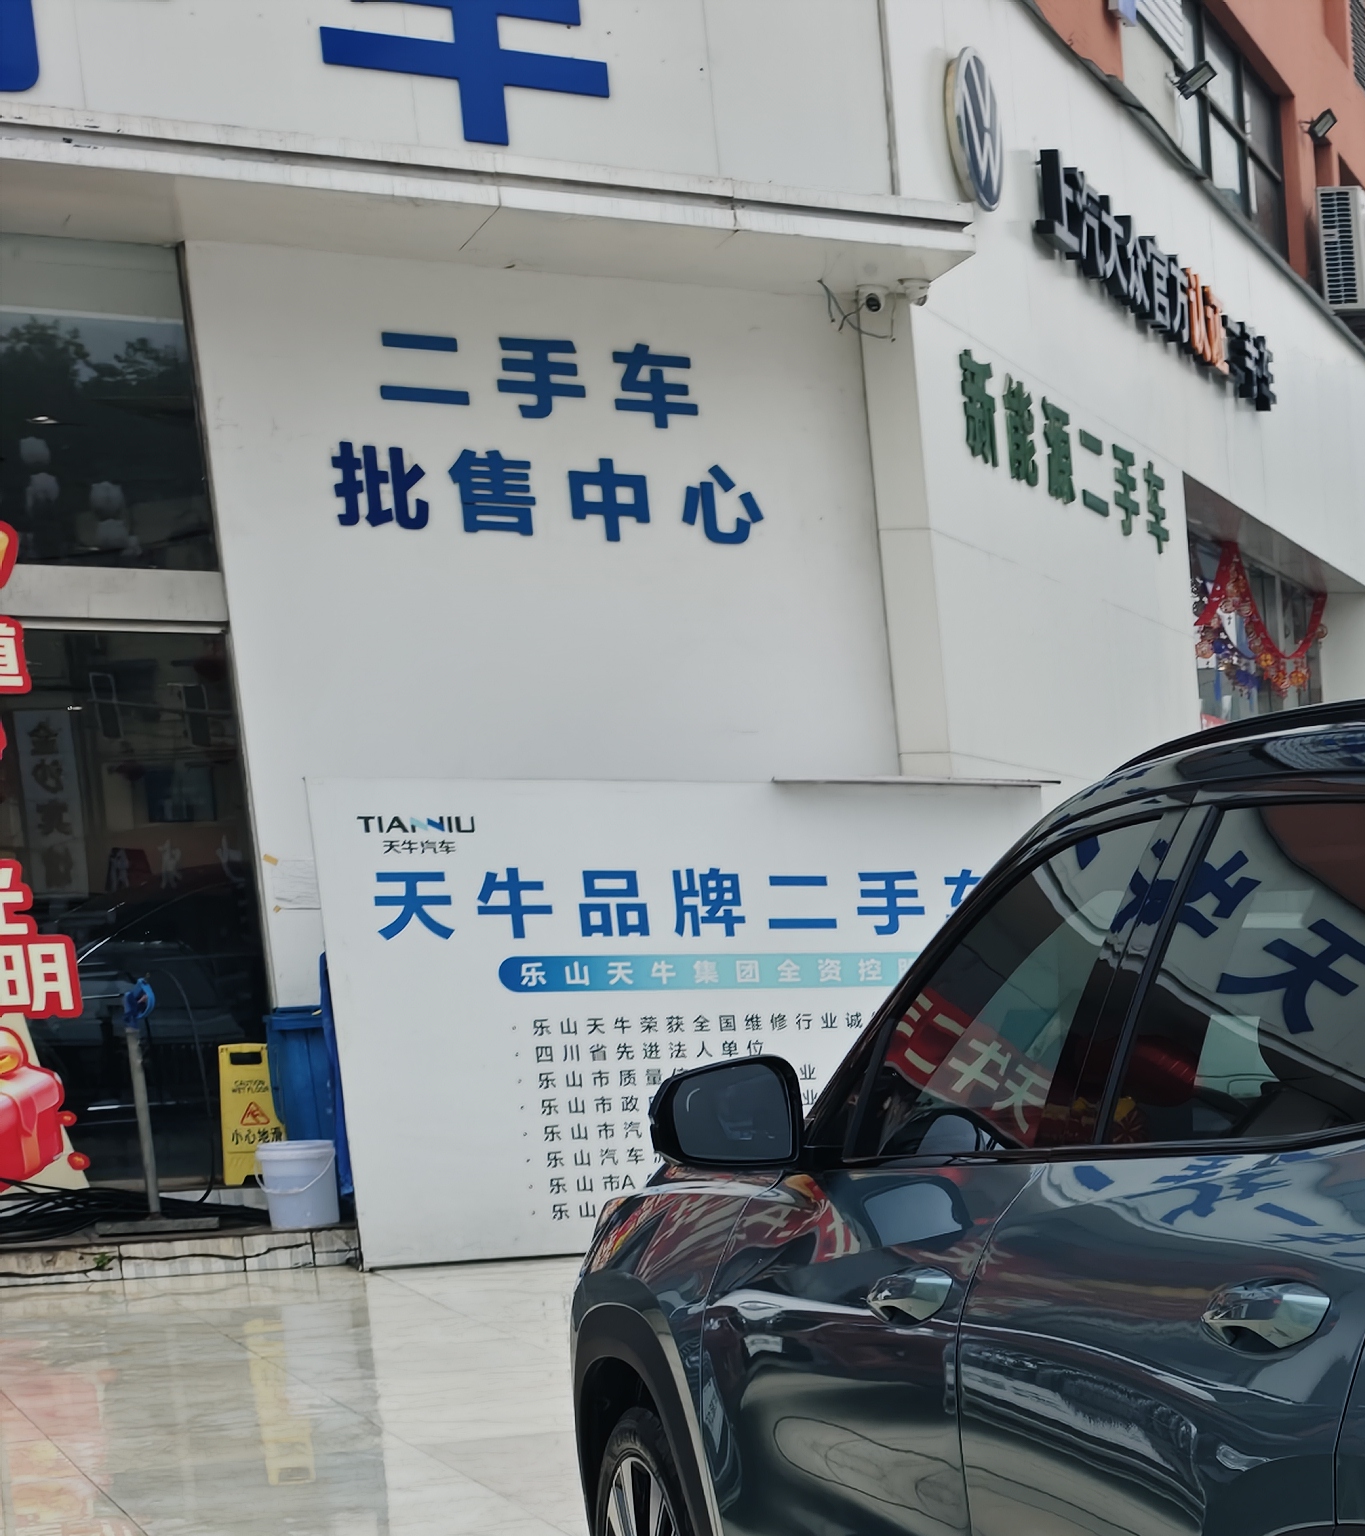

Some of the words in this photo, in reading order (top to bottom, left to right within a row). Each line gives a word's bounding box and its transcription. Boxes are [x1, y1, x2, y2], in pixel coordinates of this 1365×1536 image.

[380, 332, 699, 429] 二手车
[959, 349, 1169, 554] 新能源二手车
[330, 441, 764, 545] 批售中心
[382, 840, 457, 855] 天牛汽车
[535, 1040, 764, 1063] 四川省先进法人单位
[540, 1095, 656, 1116] 乐山市政
[543, 1121, 643, 1142] 乐山市汽
[548, 1172, 652, 1194] 乐山市A
